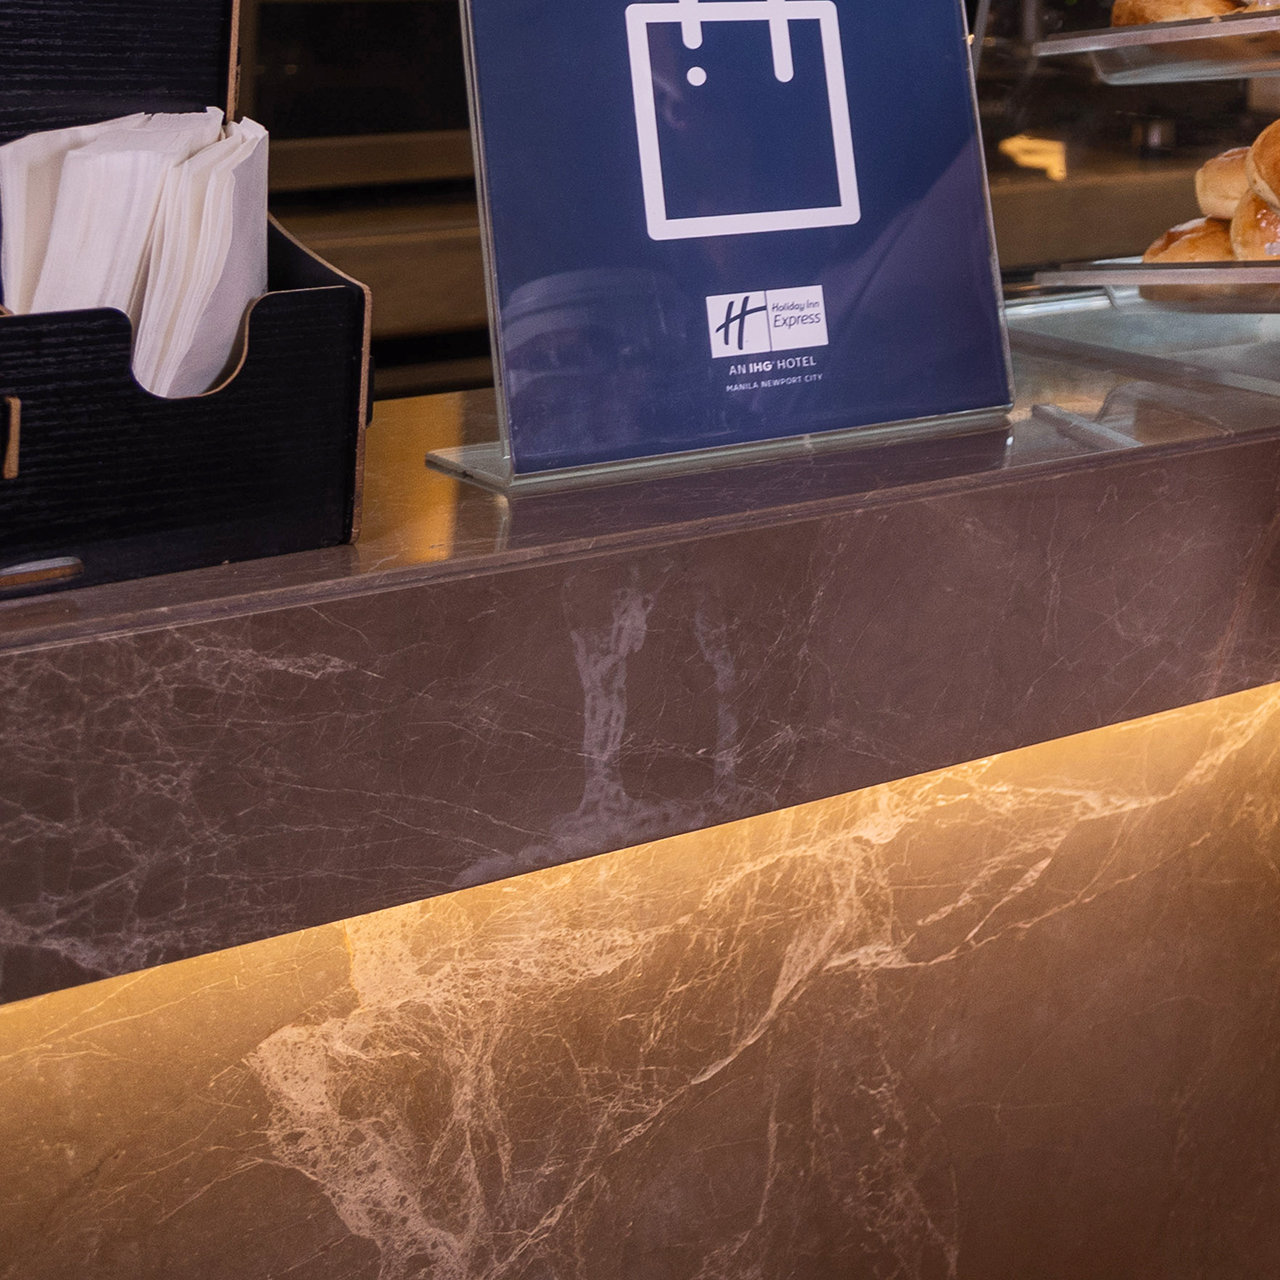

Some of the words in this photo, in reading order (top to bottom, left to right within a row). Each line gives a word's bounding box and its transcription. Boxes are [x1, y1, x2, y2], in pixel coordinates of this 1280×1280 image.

[772, 302, 805, 312] Holiday
[806, 299, 820, 309] Inn
[774, 312, 821, 329] Express
[729, 365, 747, 376] AN
[777, 356, 817, 370] HOTEL
[726, 381, 759, 392] MANILA
[761, 376, 802, 388] NEWPORT
[804, 373, 824, 383] CITY
